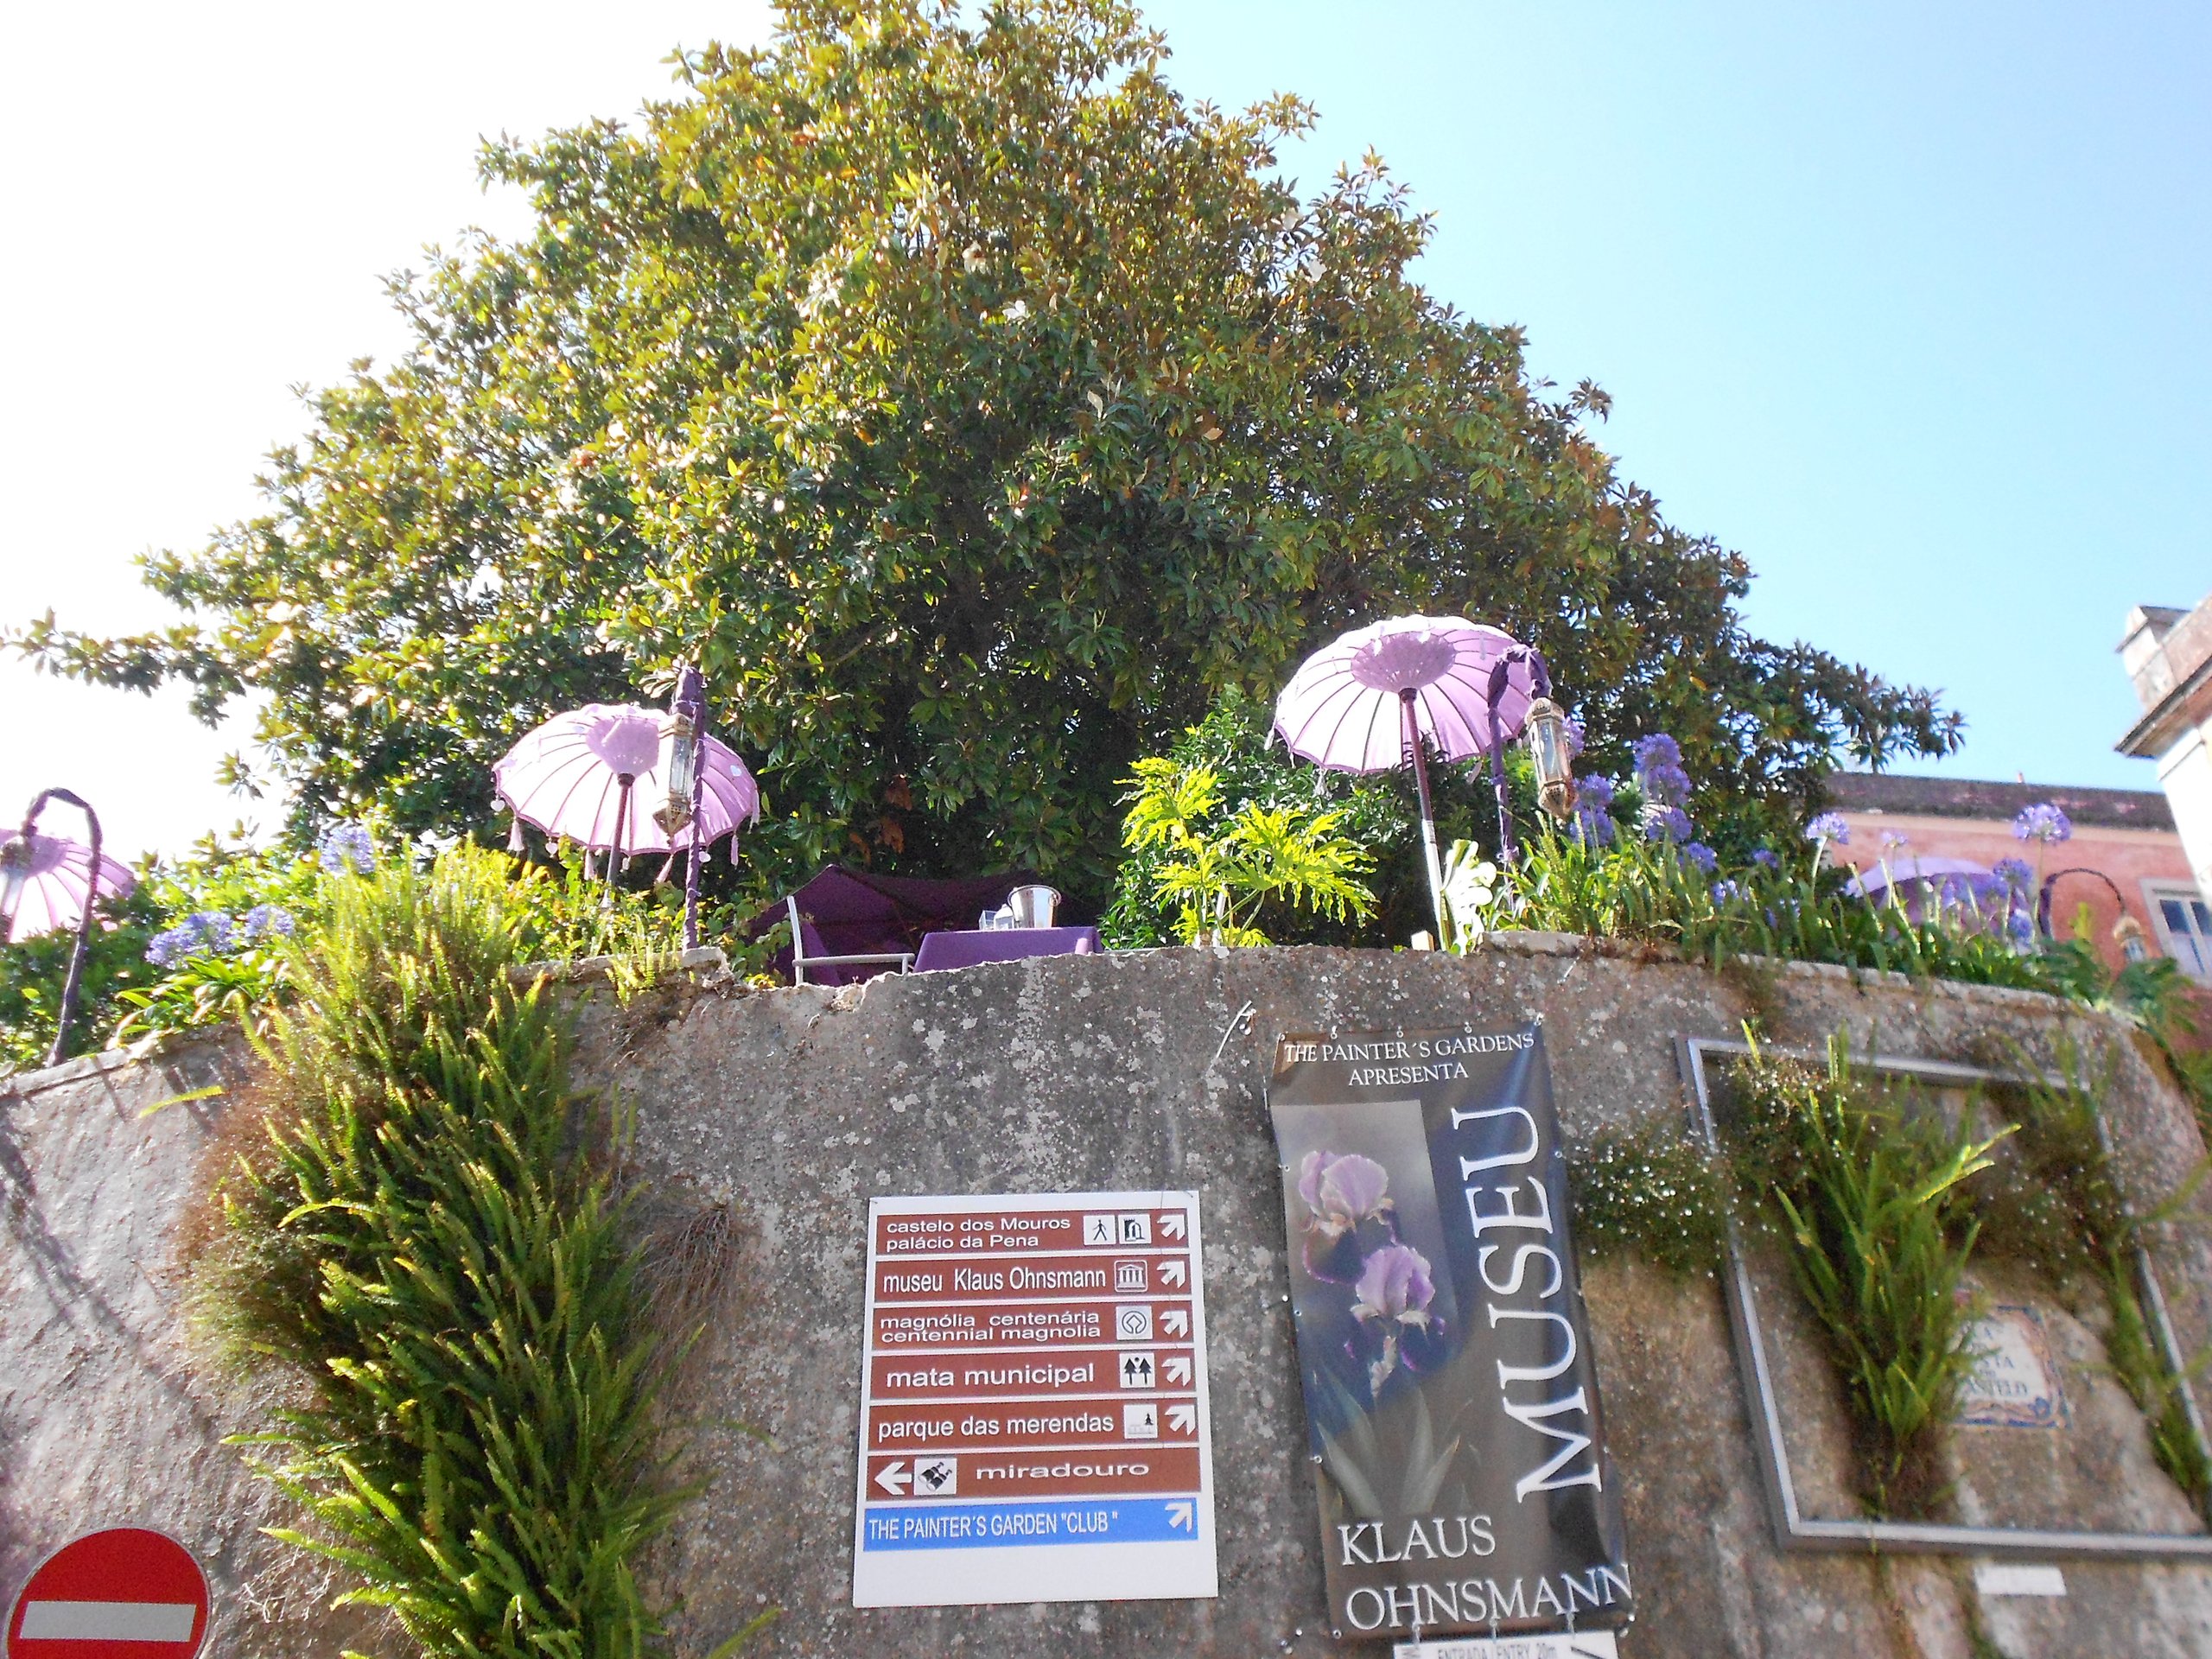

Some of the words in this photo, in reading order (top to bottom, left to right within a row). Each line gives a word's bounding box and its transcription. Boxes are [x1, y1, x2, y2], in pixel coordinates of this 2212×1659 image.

[1285, 1044, 1317, 1063] THE
[1434, 1033, 1535, 1056] GARDENS
[1349, 1062, 1469, 1086] APRESENTA
[887, 1218, 953, 1234] castelo
[960, 1217, 997, 1231] dos
[1001, 1217, 1071, 1230] Mouros
[887, 1234, 953, 1252] palácio
[959, 1234, 983, 1249] da
[989, 1234, 1039, 1247] Pena
[883, 1272, 943, 1293] museu
[954, 1268, 1003, 1291] Klaus
[1009, 1267, 1106, 1290] Ohnsmann
[1451, 1105, 1602, 1503] MUSEU
[880, 1313, 975, 1333] magnólia
[989, 1311, 1100, 1326] centenária
[881, 1327, 993, 1343] centennial
[1001, 1325, 1101, 1343] magnolia
[887, 1368, 954, 1388] mata
[964, 1363, 1094, 1388] municipal
[878, 1418, 953, 1442] parque
[960, 1415, 999, 1436] das
[1007, 1413, 1114, 1434] merendas
[976, 1462, 1149, 1480] miradouro
[868, 1518, 899, 1540] THE
[990, 1513, 1058, 1536] GARDEN
[1338, 1516, 1496, 1566] KLAUS
[1346, 1564, 1634, 1630] OHNSMANN
